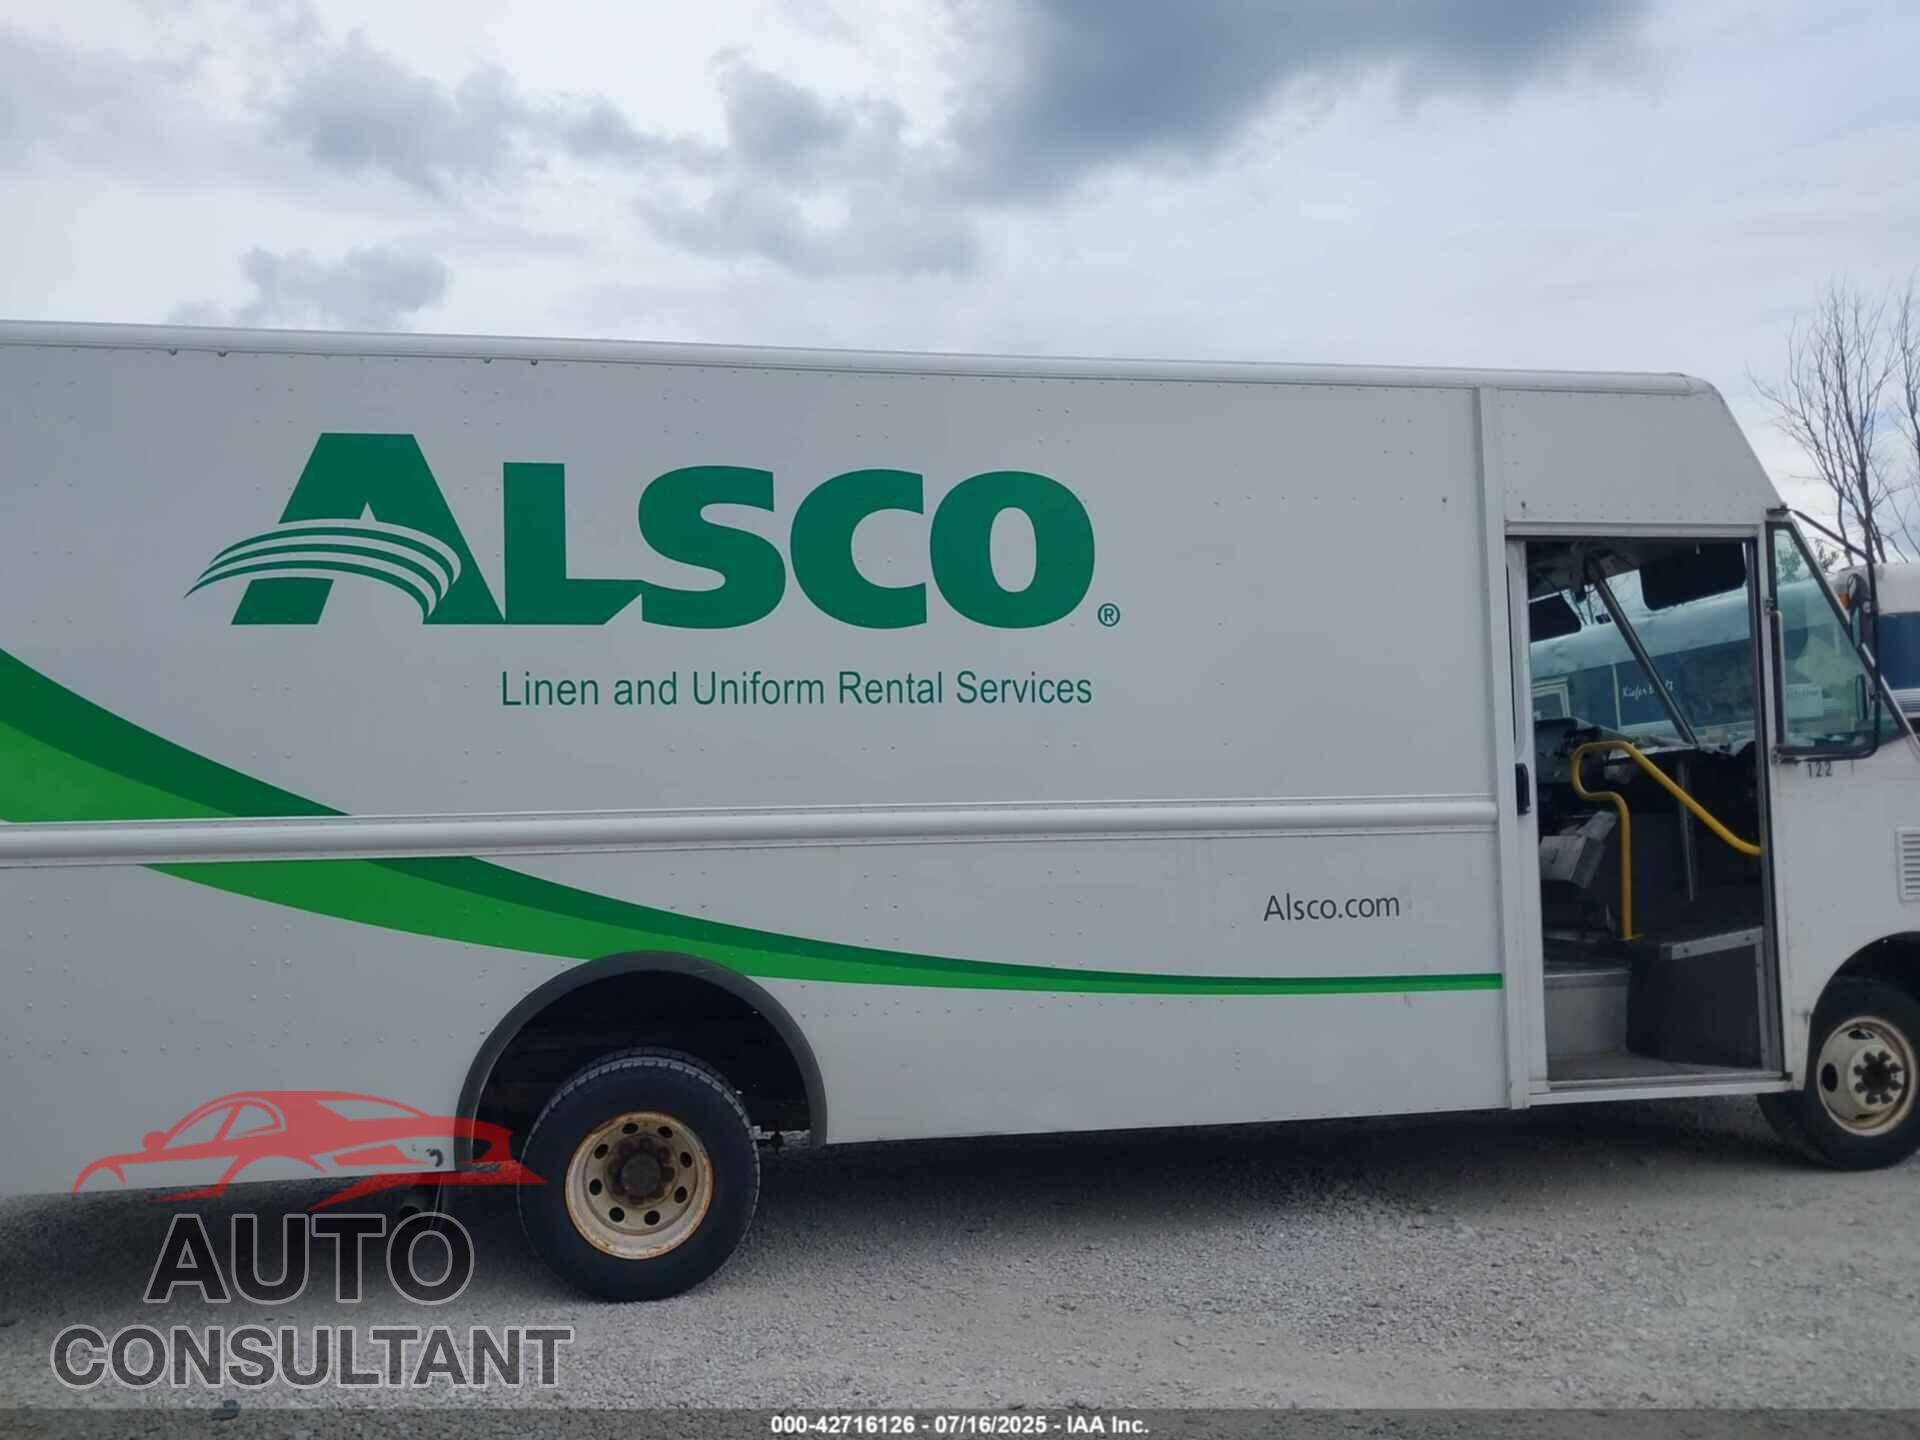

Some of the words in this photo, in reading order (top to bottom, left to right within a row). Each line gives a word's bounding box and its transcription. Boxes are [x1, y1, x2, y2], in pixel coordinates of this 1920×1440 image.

[185, 432, 1095, 630] ALSCO
[502, 671, 599, 706] Linen
[614, 671, 677, 705] and
[692, 671, 825, 705] Uniform
[838, 671, 942, 705] Rental
[957, 671, 1092, 704] Services
[1807, 761, 1833, 778] 122
[1263, 892, 1400, 921] Alsco.com
